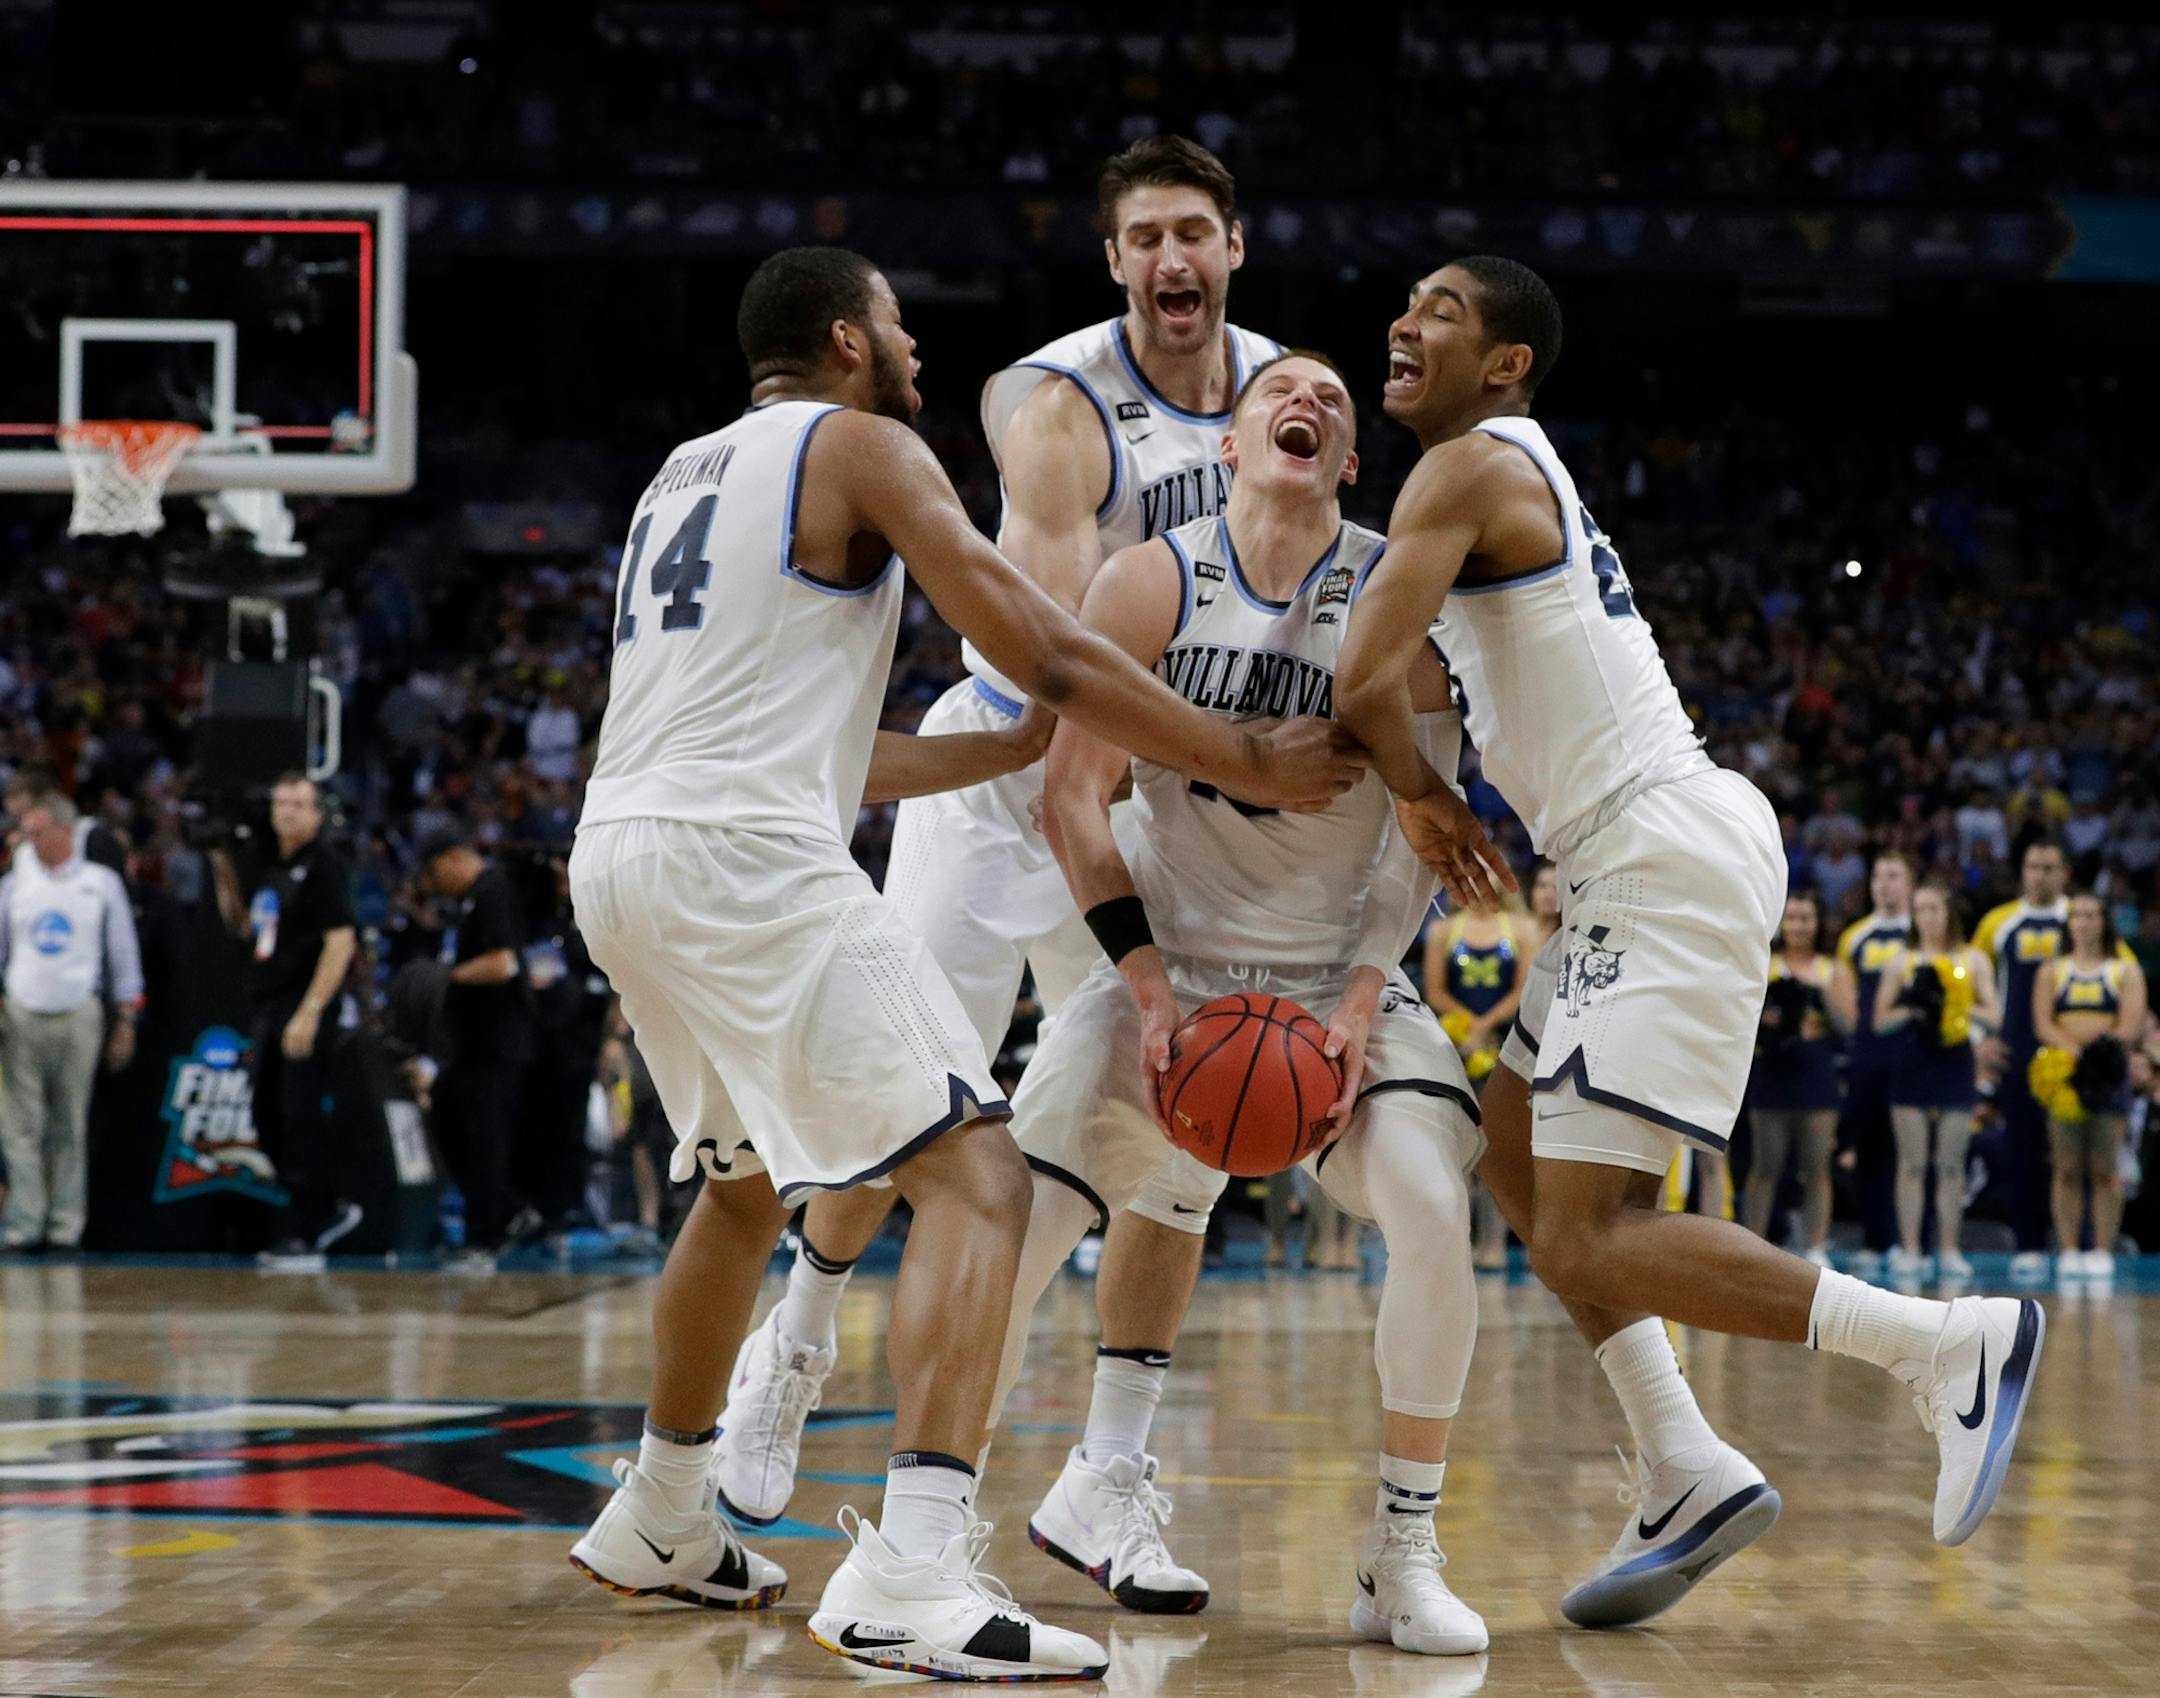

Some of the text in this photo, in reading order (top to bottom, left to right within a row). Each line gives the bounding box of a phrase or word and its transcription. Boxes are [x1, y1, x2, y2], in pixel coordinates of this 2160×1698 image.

[1121, 401, 1149, 417] RVM
[644, 444, 737, 509] SPELLMAN
[1138, 462, 1237, 541] VILLA
[616, 493, 720, 647] 14
[1199, 563, 1226, 580] RVM
[1321, 573, 1349, 587] FINAL
[1321, 581, 1349, 594] FOUR
[1579, 505, 1638, 619] 2
[1162, 644, 1337, 722] VILLANOVA
